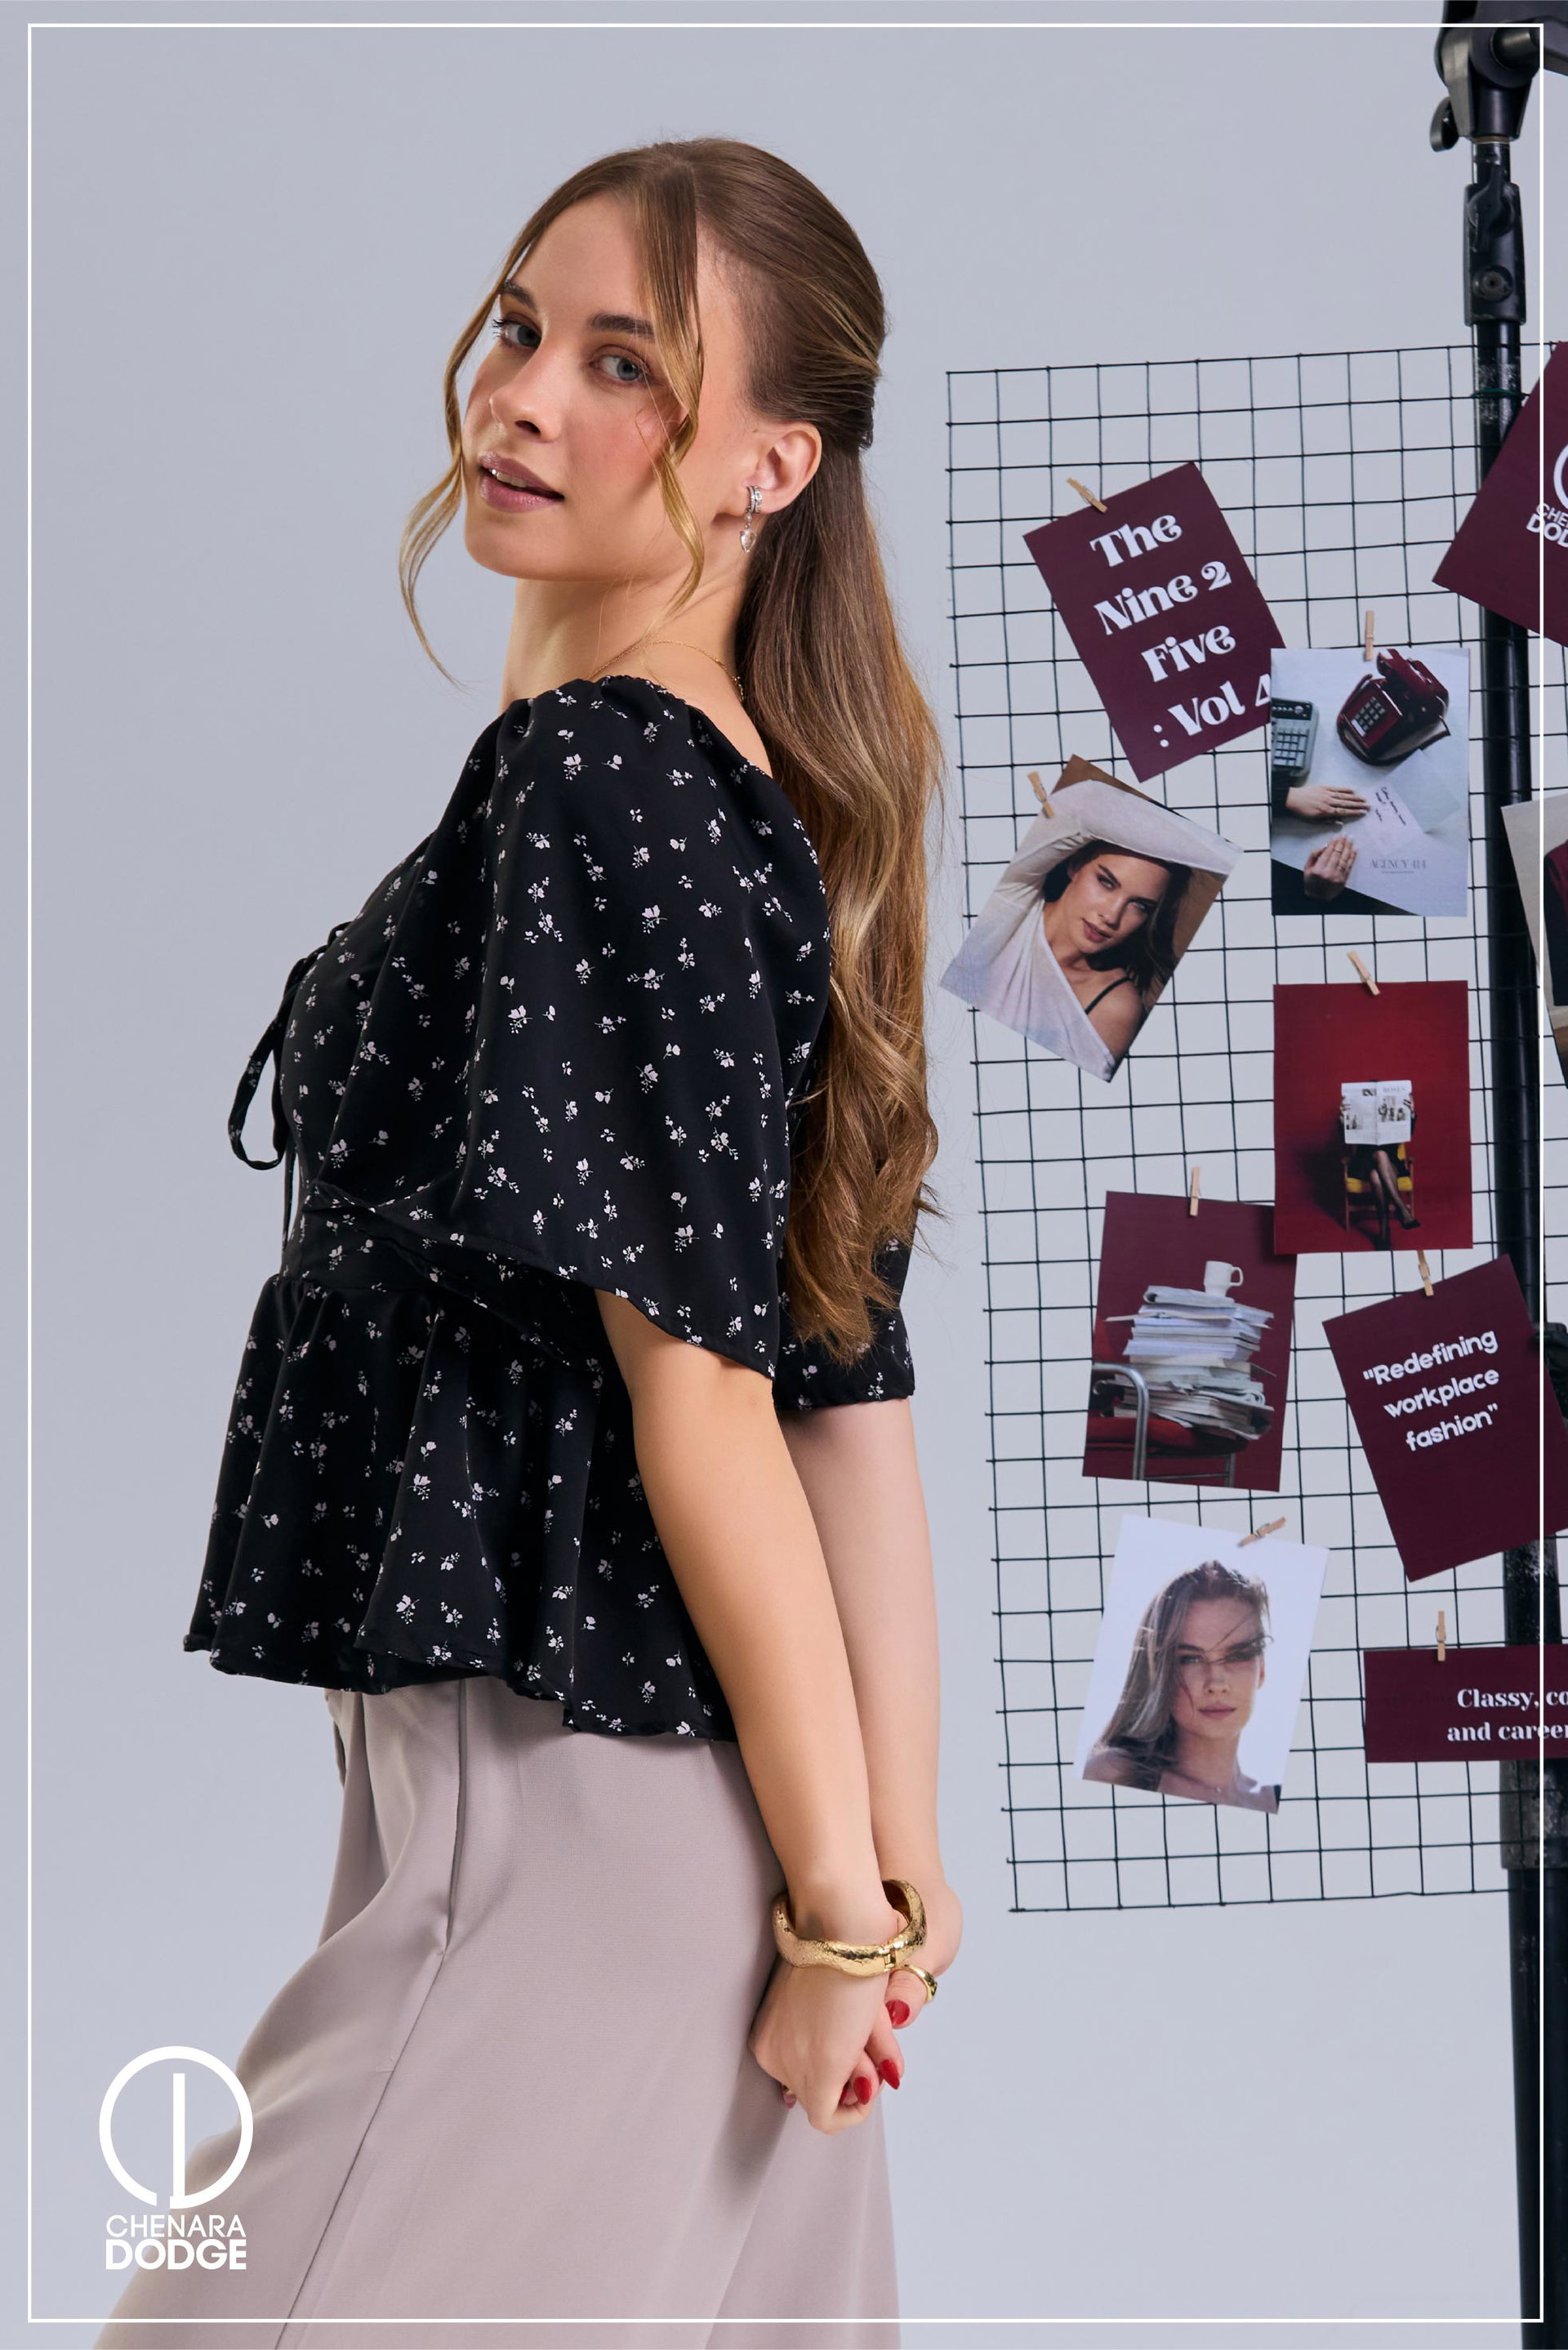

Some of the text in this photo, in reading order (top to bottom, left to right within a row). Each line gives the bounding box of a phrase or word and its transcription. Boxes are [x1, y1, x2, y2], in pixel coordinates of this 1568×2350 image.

[1536, 503, 1568, 528] CHE
[1089, 514, 1183, 567] The
[1093, 560, 1232, 635] Nine 2
[1141, 625, 1236, 682] Five
[1362, 1330, 1499, 1385] "Redefining
[1383, 1369, 1499, 1418] workplace
[1405, 1402, 1498, 1451] fashion"
[1457, 1688, 1539, 1711] Classy,
[1447, 1721, 1492, 1741] and
